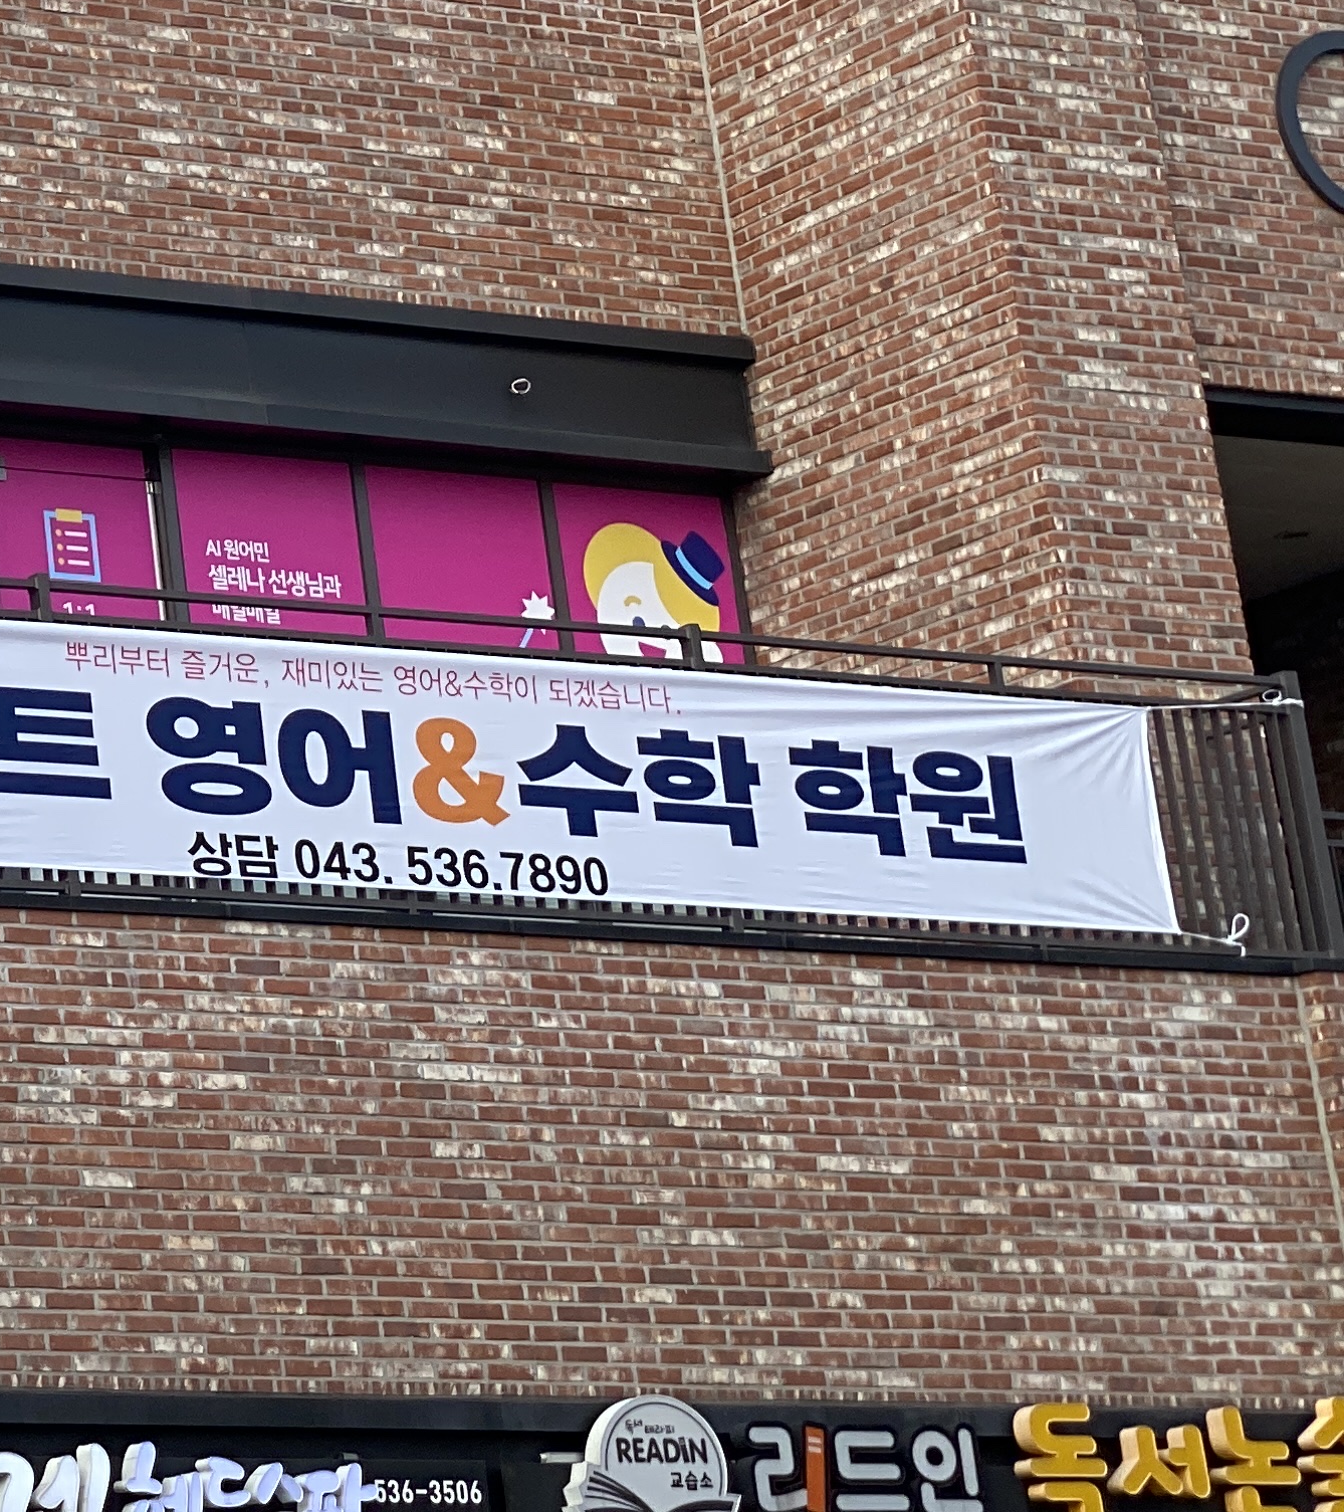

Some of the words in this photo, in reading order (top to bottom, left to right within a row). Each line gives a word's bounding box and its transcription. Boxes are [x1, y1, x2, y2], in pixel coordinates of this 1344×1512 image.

[206, 539, 222, 557] AI
[224, 539, 270, 563] 원어민
[208, 564, 266, 594] 셀레나
[268, 569, 342, 599] 선생님과
[64, 641, 170, 678] 뿌리부터
[180, 650, 269, 688] 즐거운,
[281, 658, 384, 693] 재미있는
[394, 664, 538, 704] 영어&수학이
[549, 677, 682, 715] 되겠습니다.
[146, 695, 762, 849] 영어&수학
[788, 738, 1028, 864] 학원
[187, 831, 279, 878] 상담
[294, 838, 393, 885] 043.
[407, 845, 609, 896] 536.7890
[374, 1479, 483, 1505] 536-3506
[670, 1470, 714, 1491] 교습소
